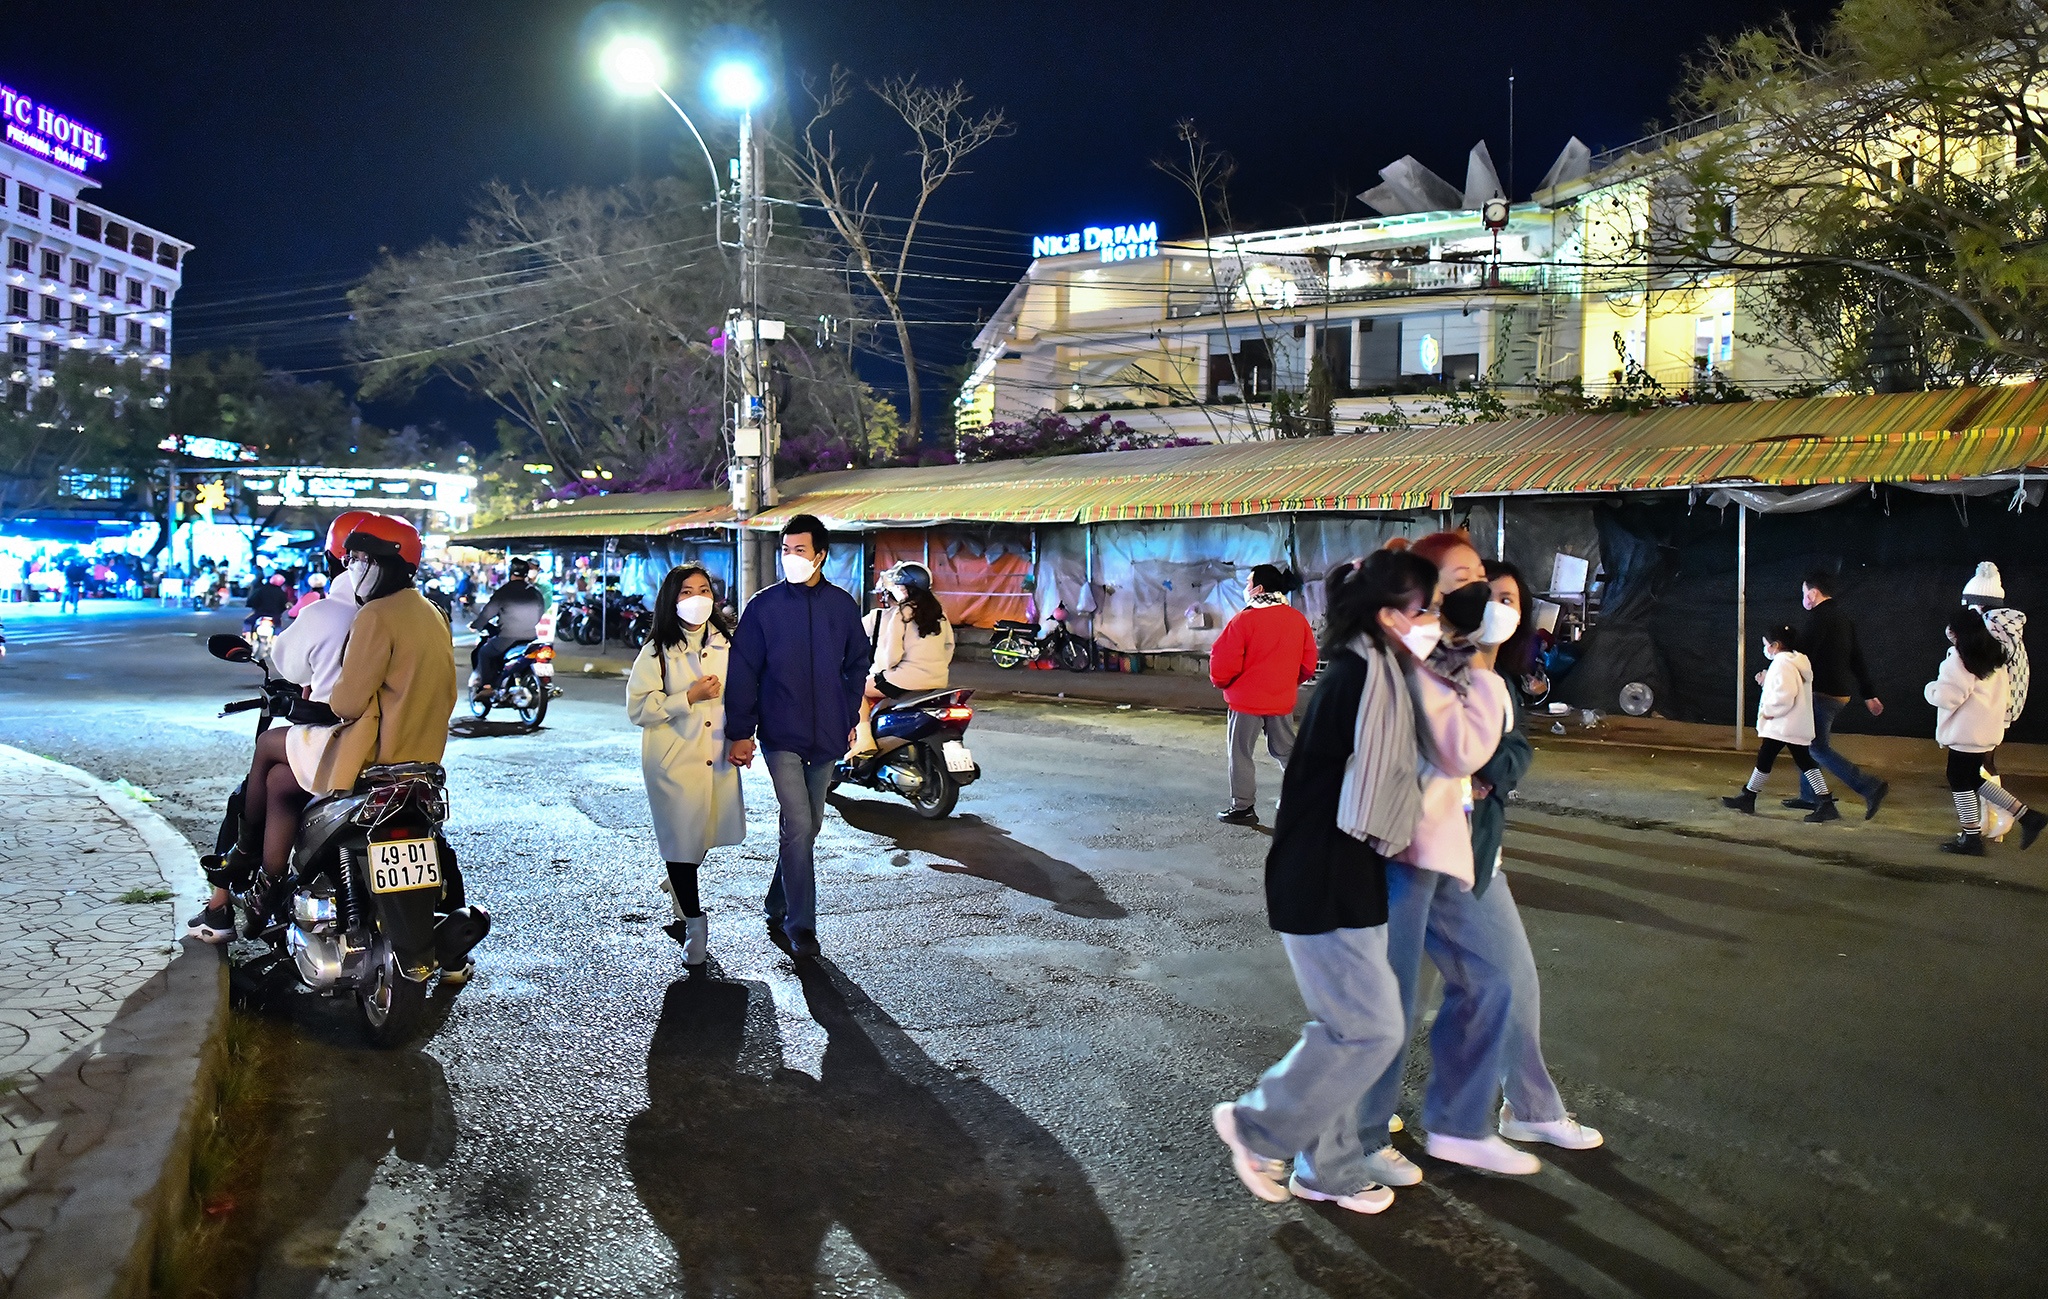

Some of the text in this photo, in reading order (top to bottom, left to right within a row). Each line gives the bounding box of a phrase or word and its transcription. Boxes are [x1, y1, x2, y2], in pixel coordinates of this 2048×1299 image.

[0, 86, 107, 161] TC HOTEL
[1032, 221, 1158, 258] NICE DREAM
[1101, 241, 1158, 263] HOTEL
[381, 843, 427, 866] 49-D1
[375, 863, 437, 889] 601.75
